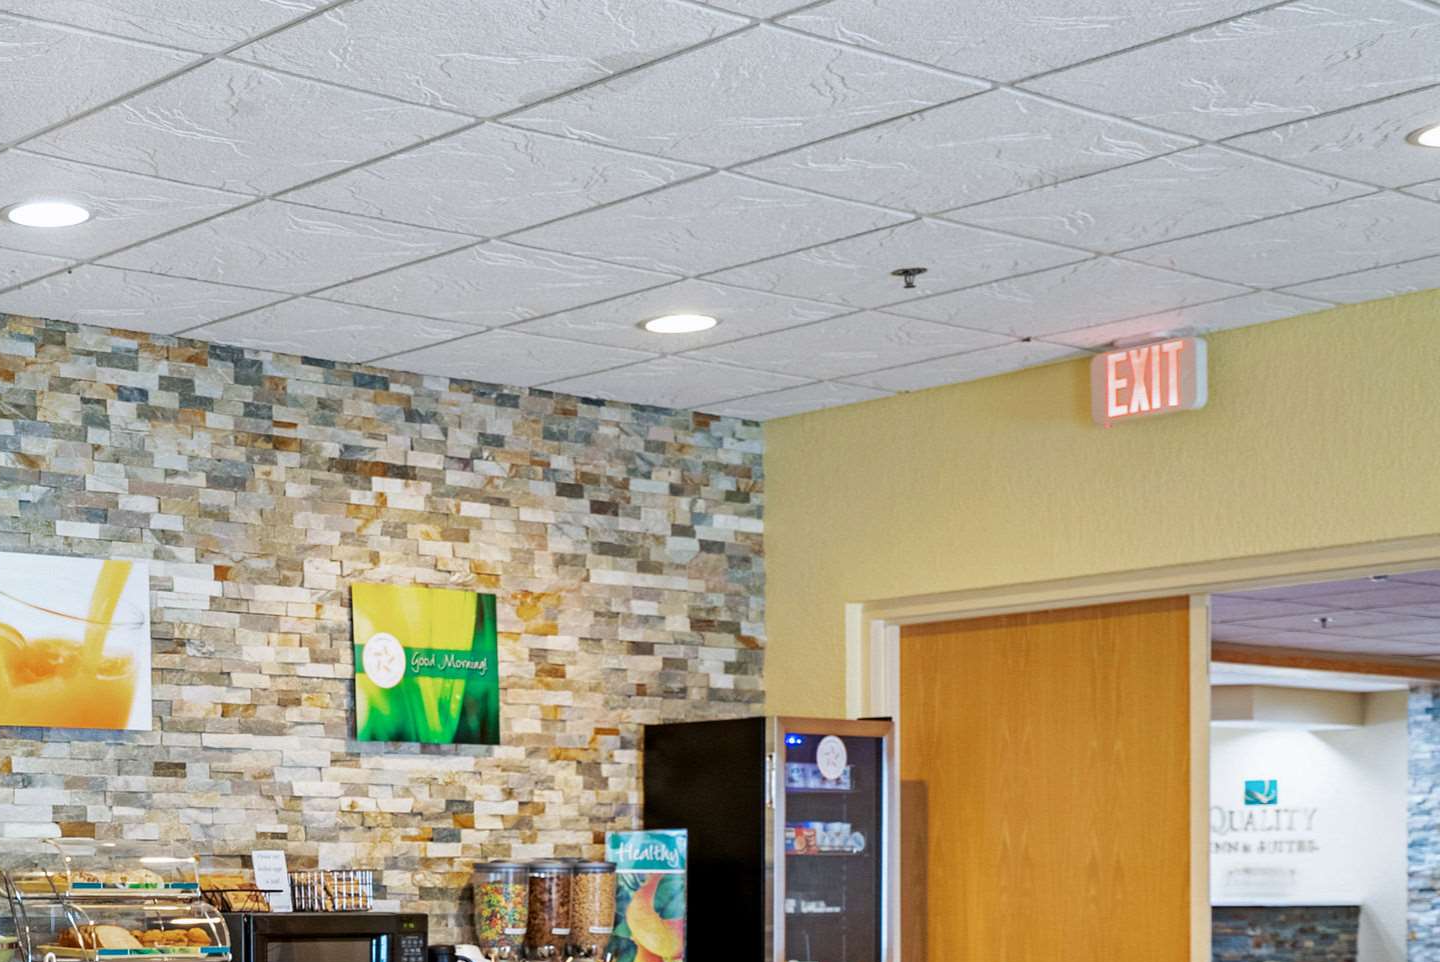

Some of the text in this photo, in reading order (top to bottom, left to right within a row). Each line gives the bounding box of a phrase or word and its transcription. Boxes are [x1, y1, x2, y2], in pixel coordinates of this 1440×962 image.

[1106, 341, 1184, 417] EXIT
[410, 652, 436, 673] Good
[1211, 805, 1318, 836] QUALITY
[616, 842, 680, 868] Healthy
[1211, 842, 1239, 853] NN
